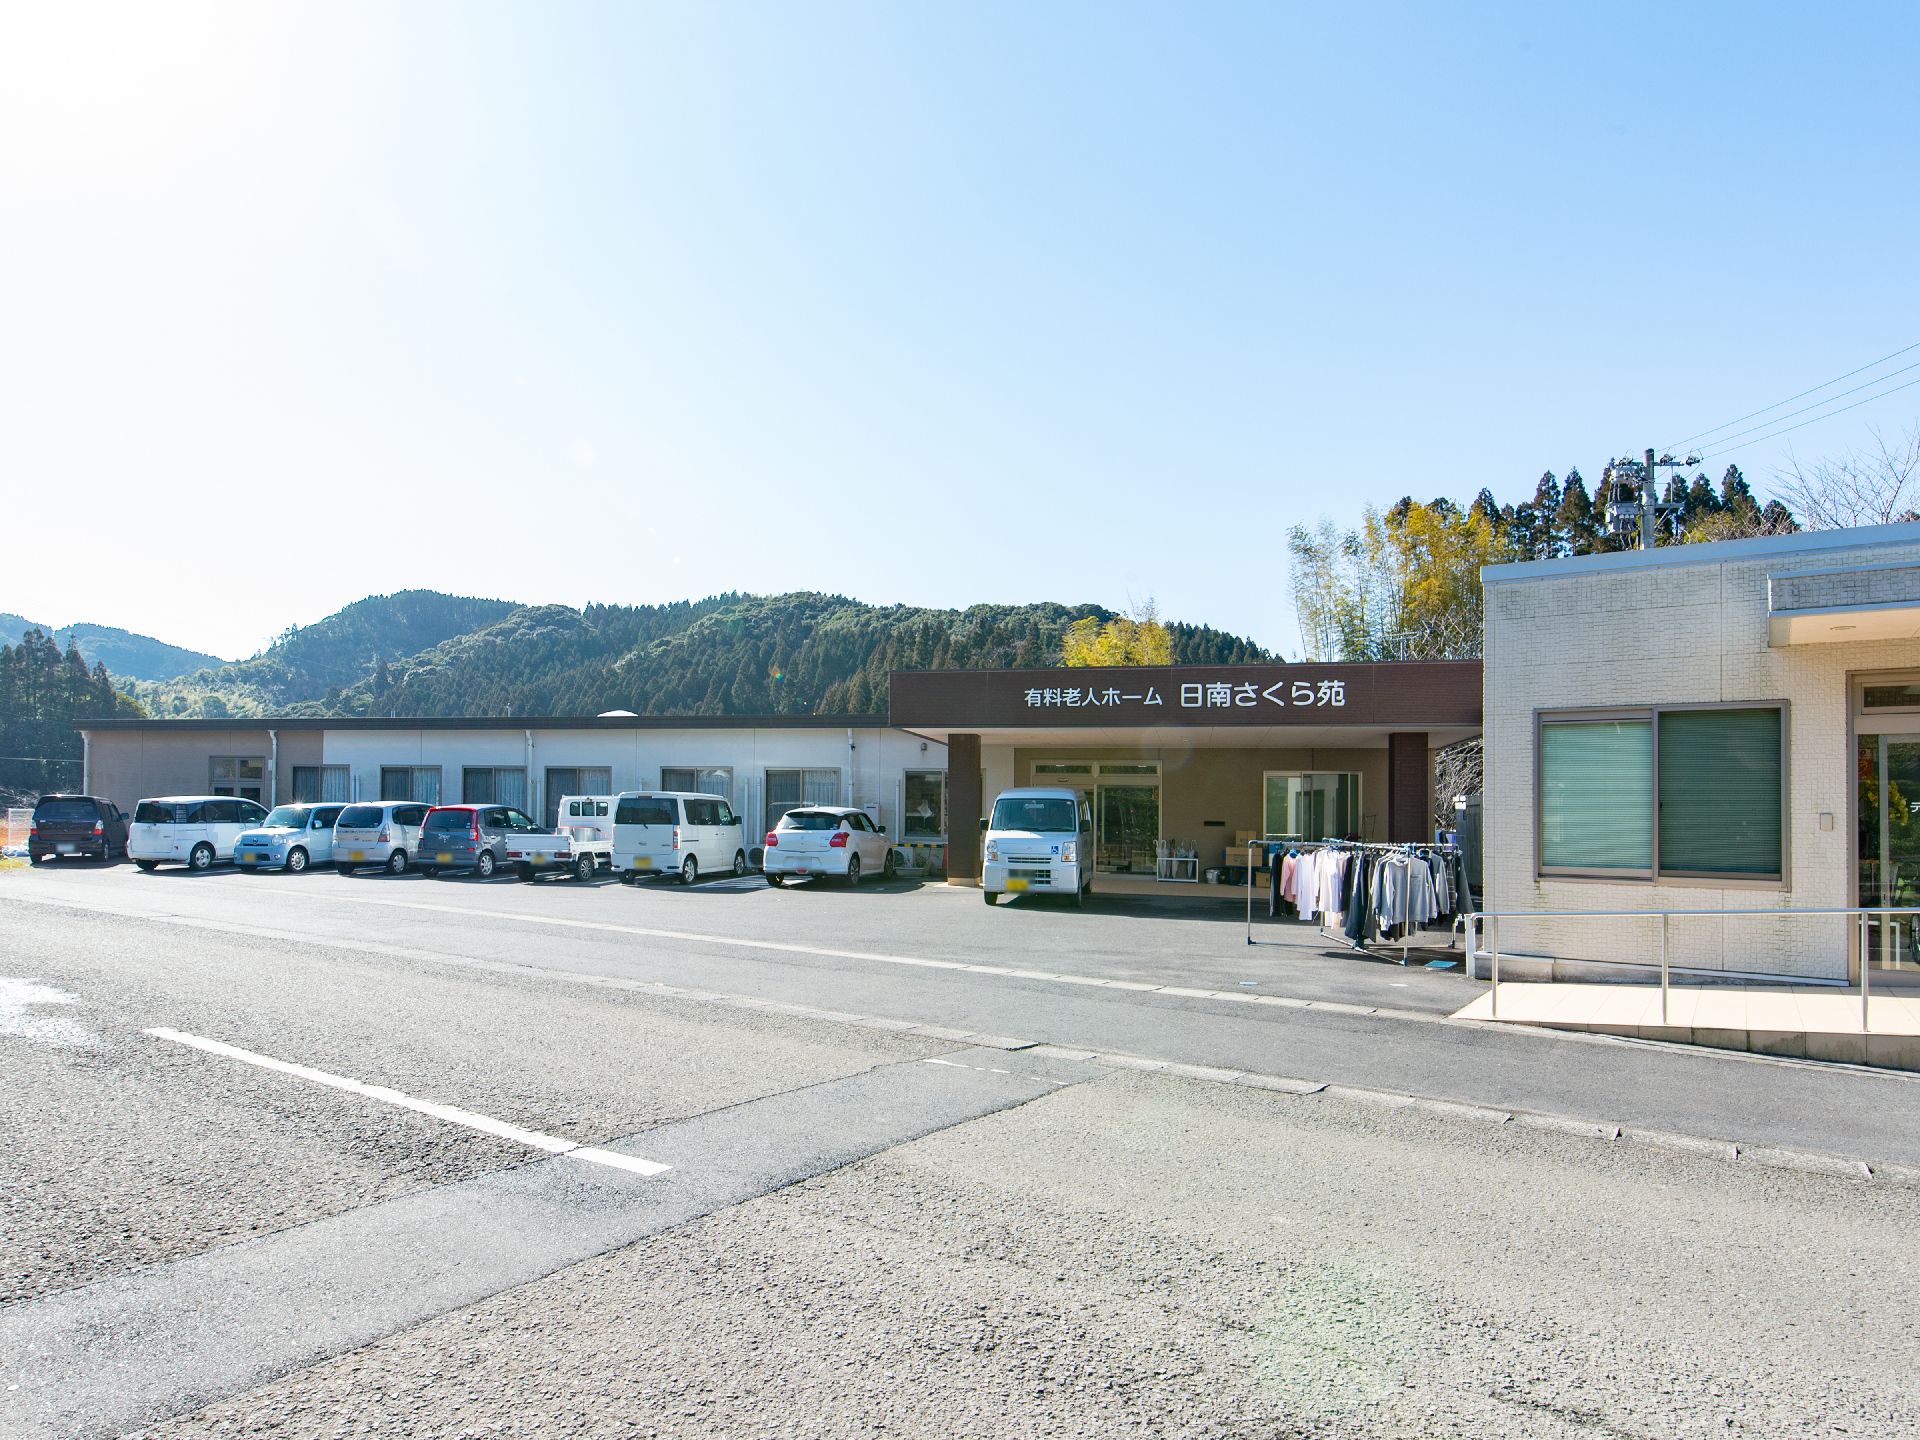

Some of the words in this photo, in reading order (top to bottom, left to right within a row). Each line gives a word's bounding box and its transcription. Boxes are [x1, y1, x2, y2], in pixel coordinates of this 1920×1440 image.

[1024, 687, 1163, 707] 有料老人ホーム
[1181, 680, 1346, 708] 日南さくら苑
